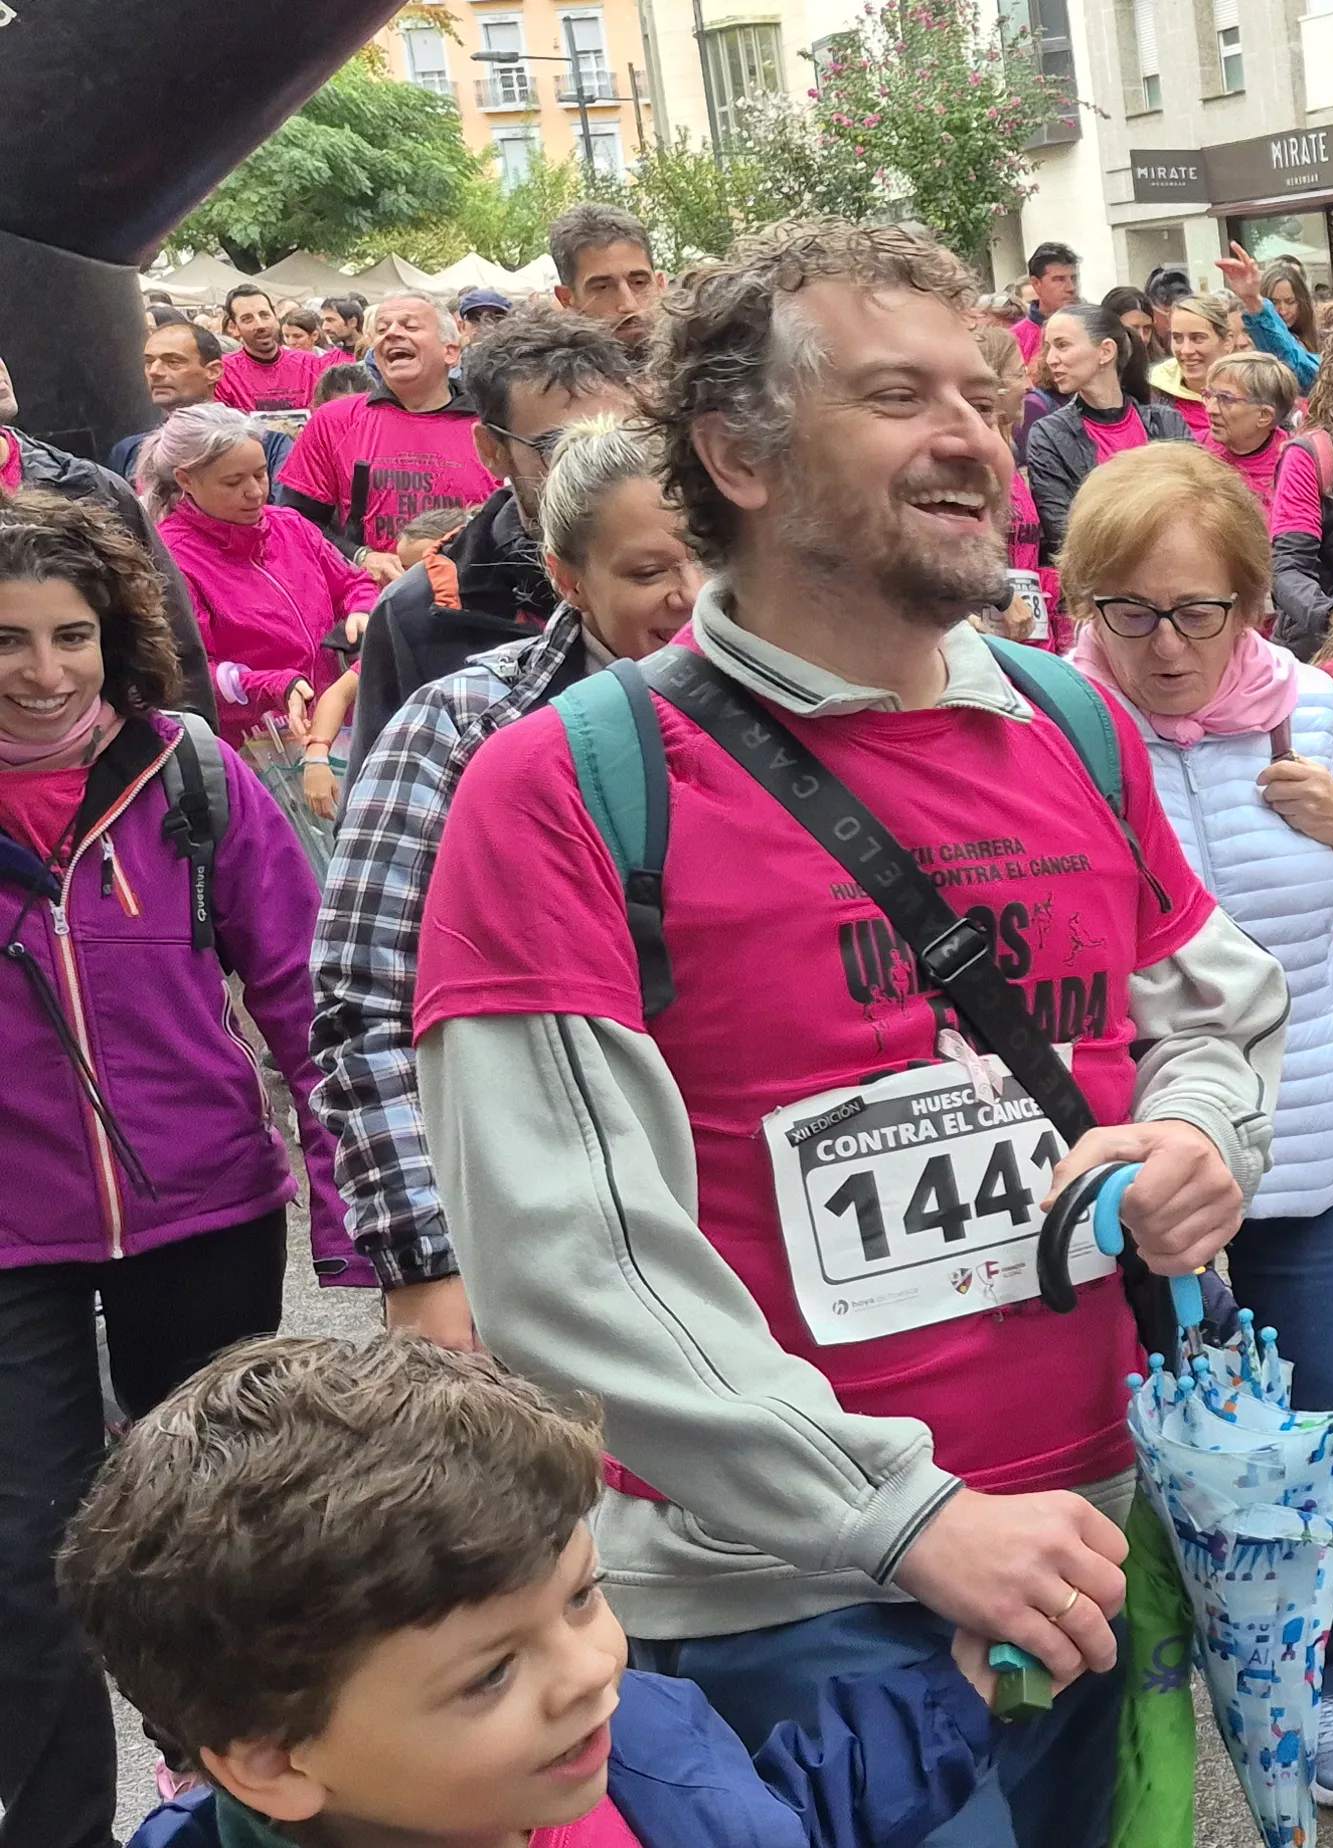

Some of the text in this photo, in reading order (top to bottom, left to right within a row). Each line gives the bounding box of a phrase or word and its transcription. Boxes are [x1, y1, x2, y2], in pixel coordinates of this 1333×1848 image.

[1271, 132, 1329, 170] MIRATE
[1136, 166, 1198, 181] MIRATE
[373, 469, 434, 494] UNIDOS
[398, 493, 417, 516] EN
[938, 838, 1027, 862] CARRERA
[1005, 858, 1028, 880] EL
[1030, 852, 1092, 877] CÁNCER
[195, 866, 208, 922] Quechua
[911, 1088, 979, 1117] HUESC
[810, 1101, 861, 1134] EDICIÓN
[815, 1122, 938, 1163] CONTRA
[943, 1112, 974, 1135] EL
